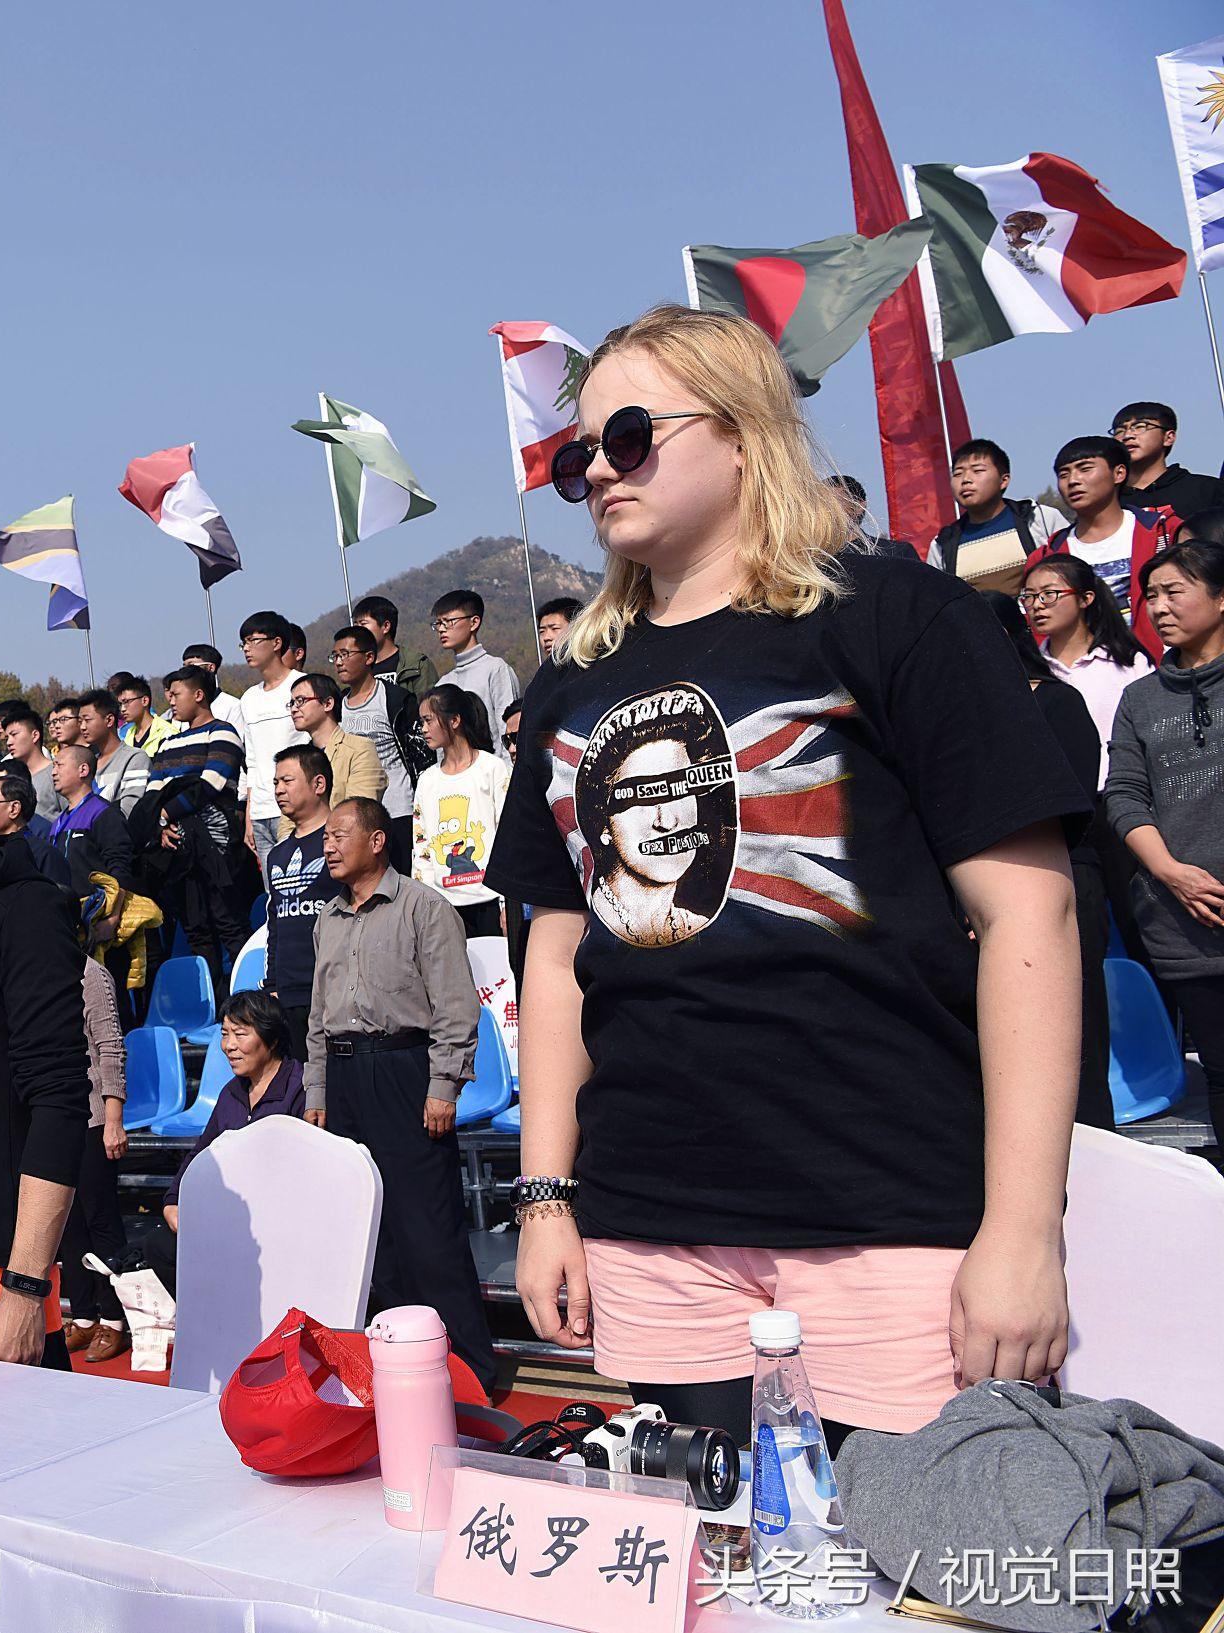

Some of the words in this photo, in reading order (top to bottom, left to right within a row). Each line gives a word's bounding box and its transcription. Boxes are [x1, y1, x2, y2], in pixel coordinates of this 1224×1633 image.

[614, 788, 634, 800] GOD
[638, 783, 668, 797] Save
[670, 781, 688, 796] THE
[687, 763, 733, 785] QUEEN
[457, 873, 483, 884] Simpson
[277, 897, 327, 918] didas
[561, 1406, 587, 1417] OS
[459, 1502, 670, 1604] 俄罗斯
